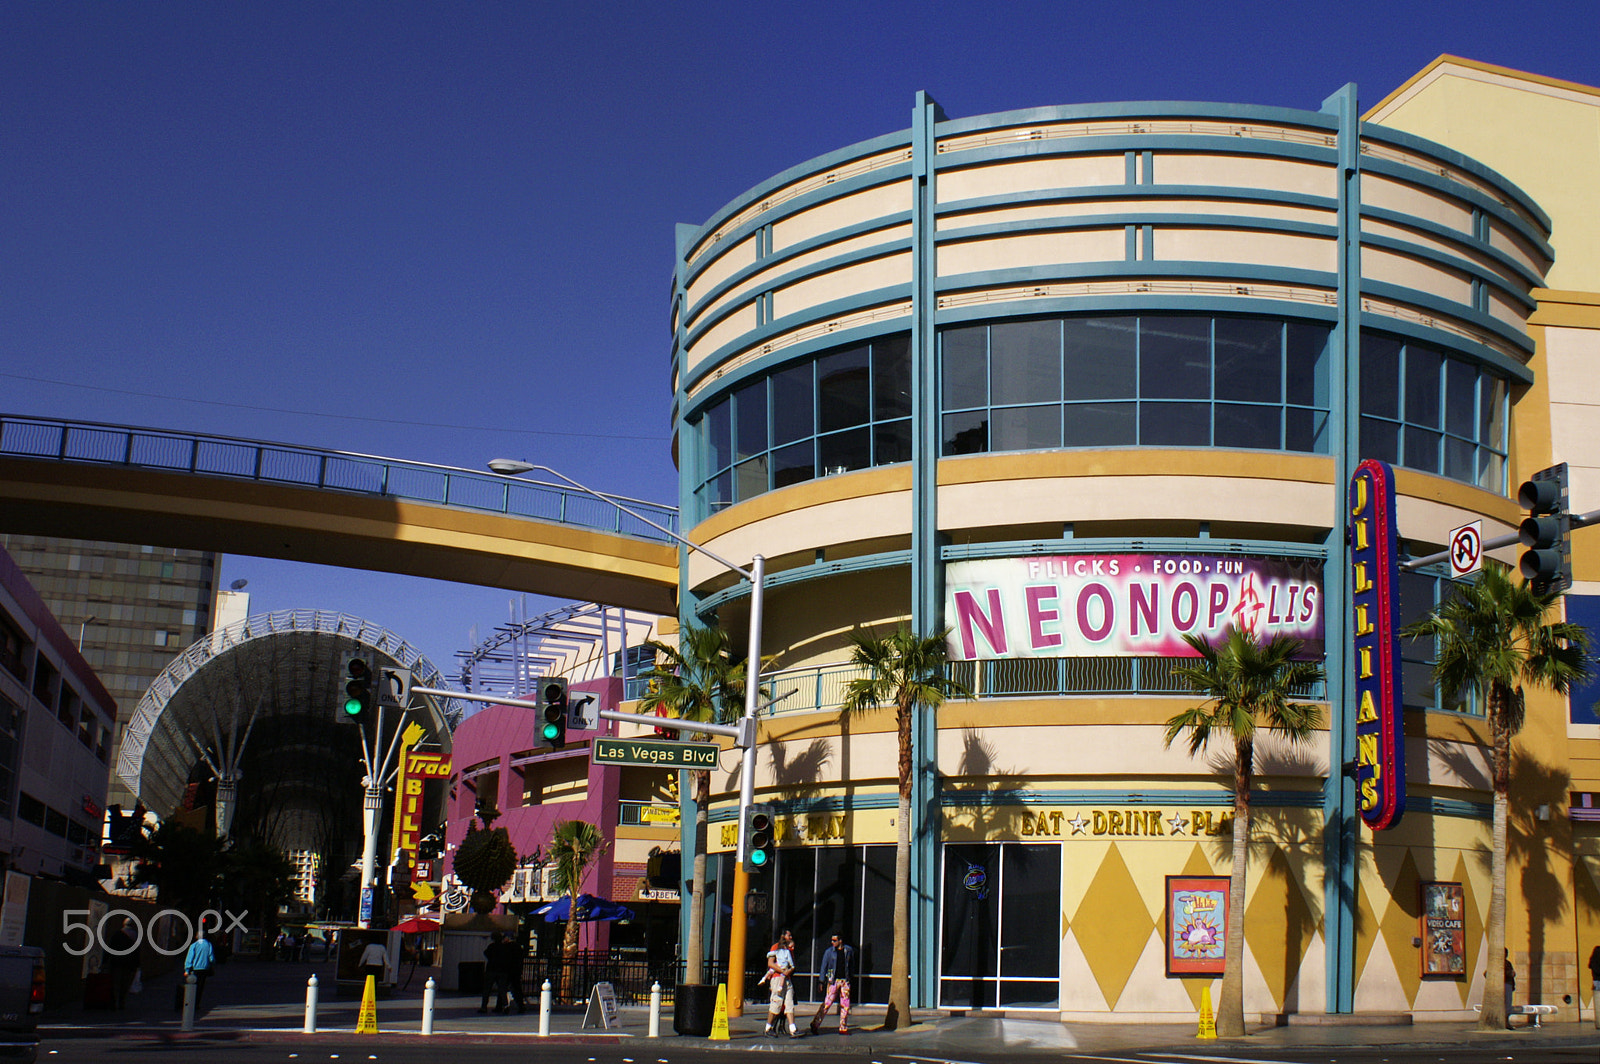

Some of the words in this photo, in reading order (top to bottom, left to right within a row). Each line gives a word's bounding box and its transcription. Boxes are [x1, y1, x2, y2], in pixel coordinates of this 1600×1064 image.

[1029, 559, 1120, 579] FLICKS
[1152, 560, 1201, 575] FOOD
[1216, 561, 1243, 574] FUN
[1353, 474, 1381, 811] JILLIAN'S
[382, 694, 404, 704] ONLY
[572, 716, 594, 726] ONLY
[598, 744, 625, 758] Las
[631, 746, 675, 763] Vegas
[682, 749, 715, 763] Blvd
[1021, 811, 1065, 836] EAT
[1092, 811, 1163, 836] DRINK
[1427, 919, 1444, 928] VIDEO
